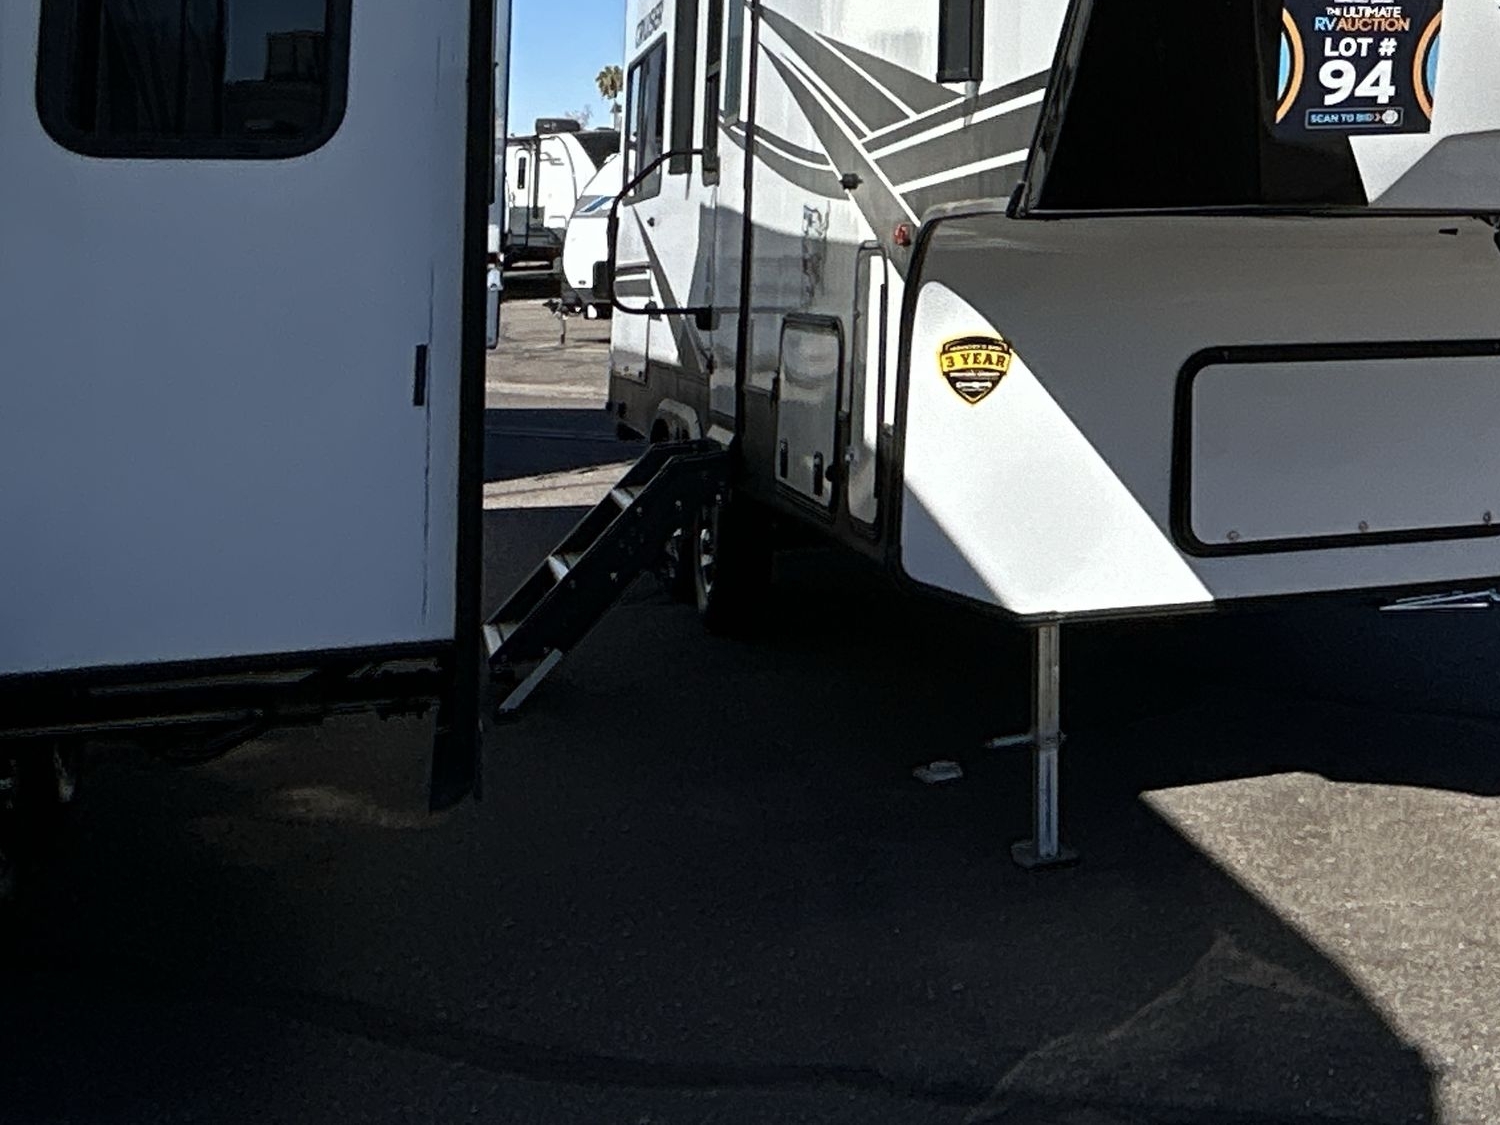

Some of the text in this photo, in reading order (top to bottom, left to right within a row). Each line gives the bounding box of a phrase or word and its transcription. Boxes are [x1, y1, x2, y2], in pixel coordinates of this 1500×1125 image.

[1342, 6, 1402, 18] ULTIMATE
[1335, 17, 1411, 32] AUCTION
[1324, 36, 1398, 57] LOT #
[1318, 59, 1396, 106] 94
[1310, 113, 1339, 123] SCAN
[1340, 113, 1355, 122] TO
[944, 352, 1007, 368] 3 YEAR
